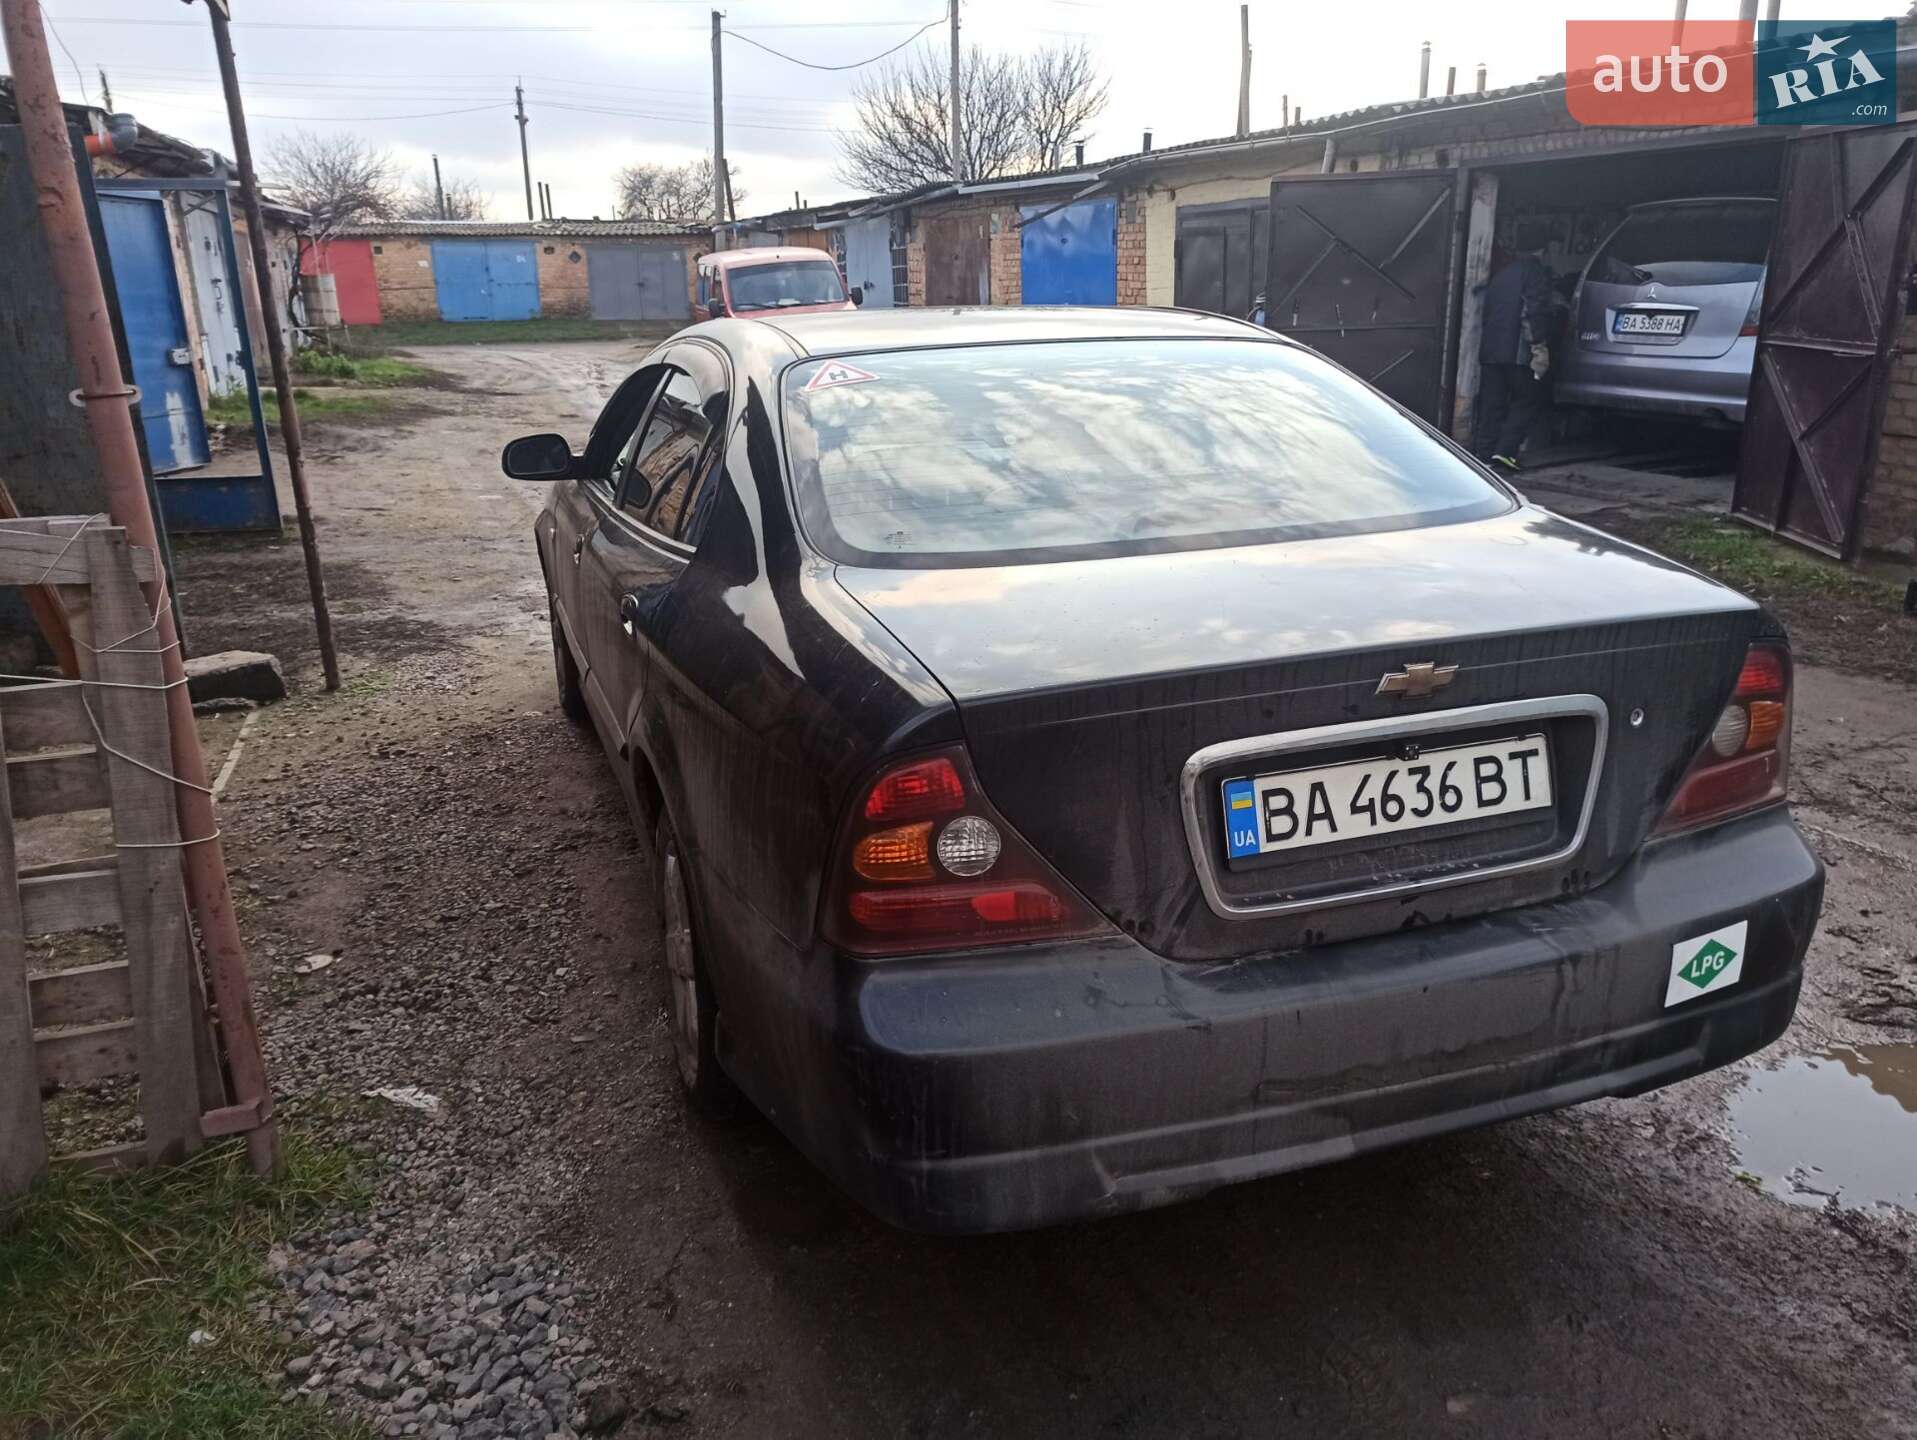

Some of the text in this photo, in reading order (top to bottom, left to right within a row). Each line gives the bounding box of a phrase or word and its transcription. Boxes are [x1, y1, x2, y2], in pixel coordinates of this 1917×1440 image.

[1622, 316, 1637, 329] BA
[1665, 318, 1681, 331] HA
[1261, 749, 1539, 843] BA 4636 BT
[1234, 831, 1256, 847] UA
[1691, 951, 1725, 978] LPG
